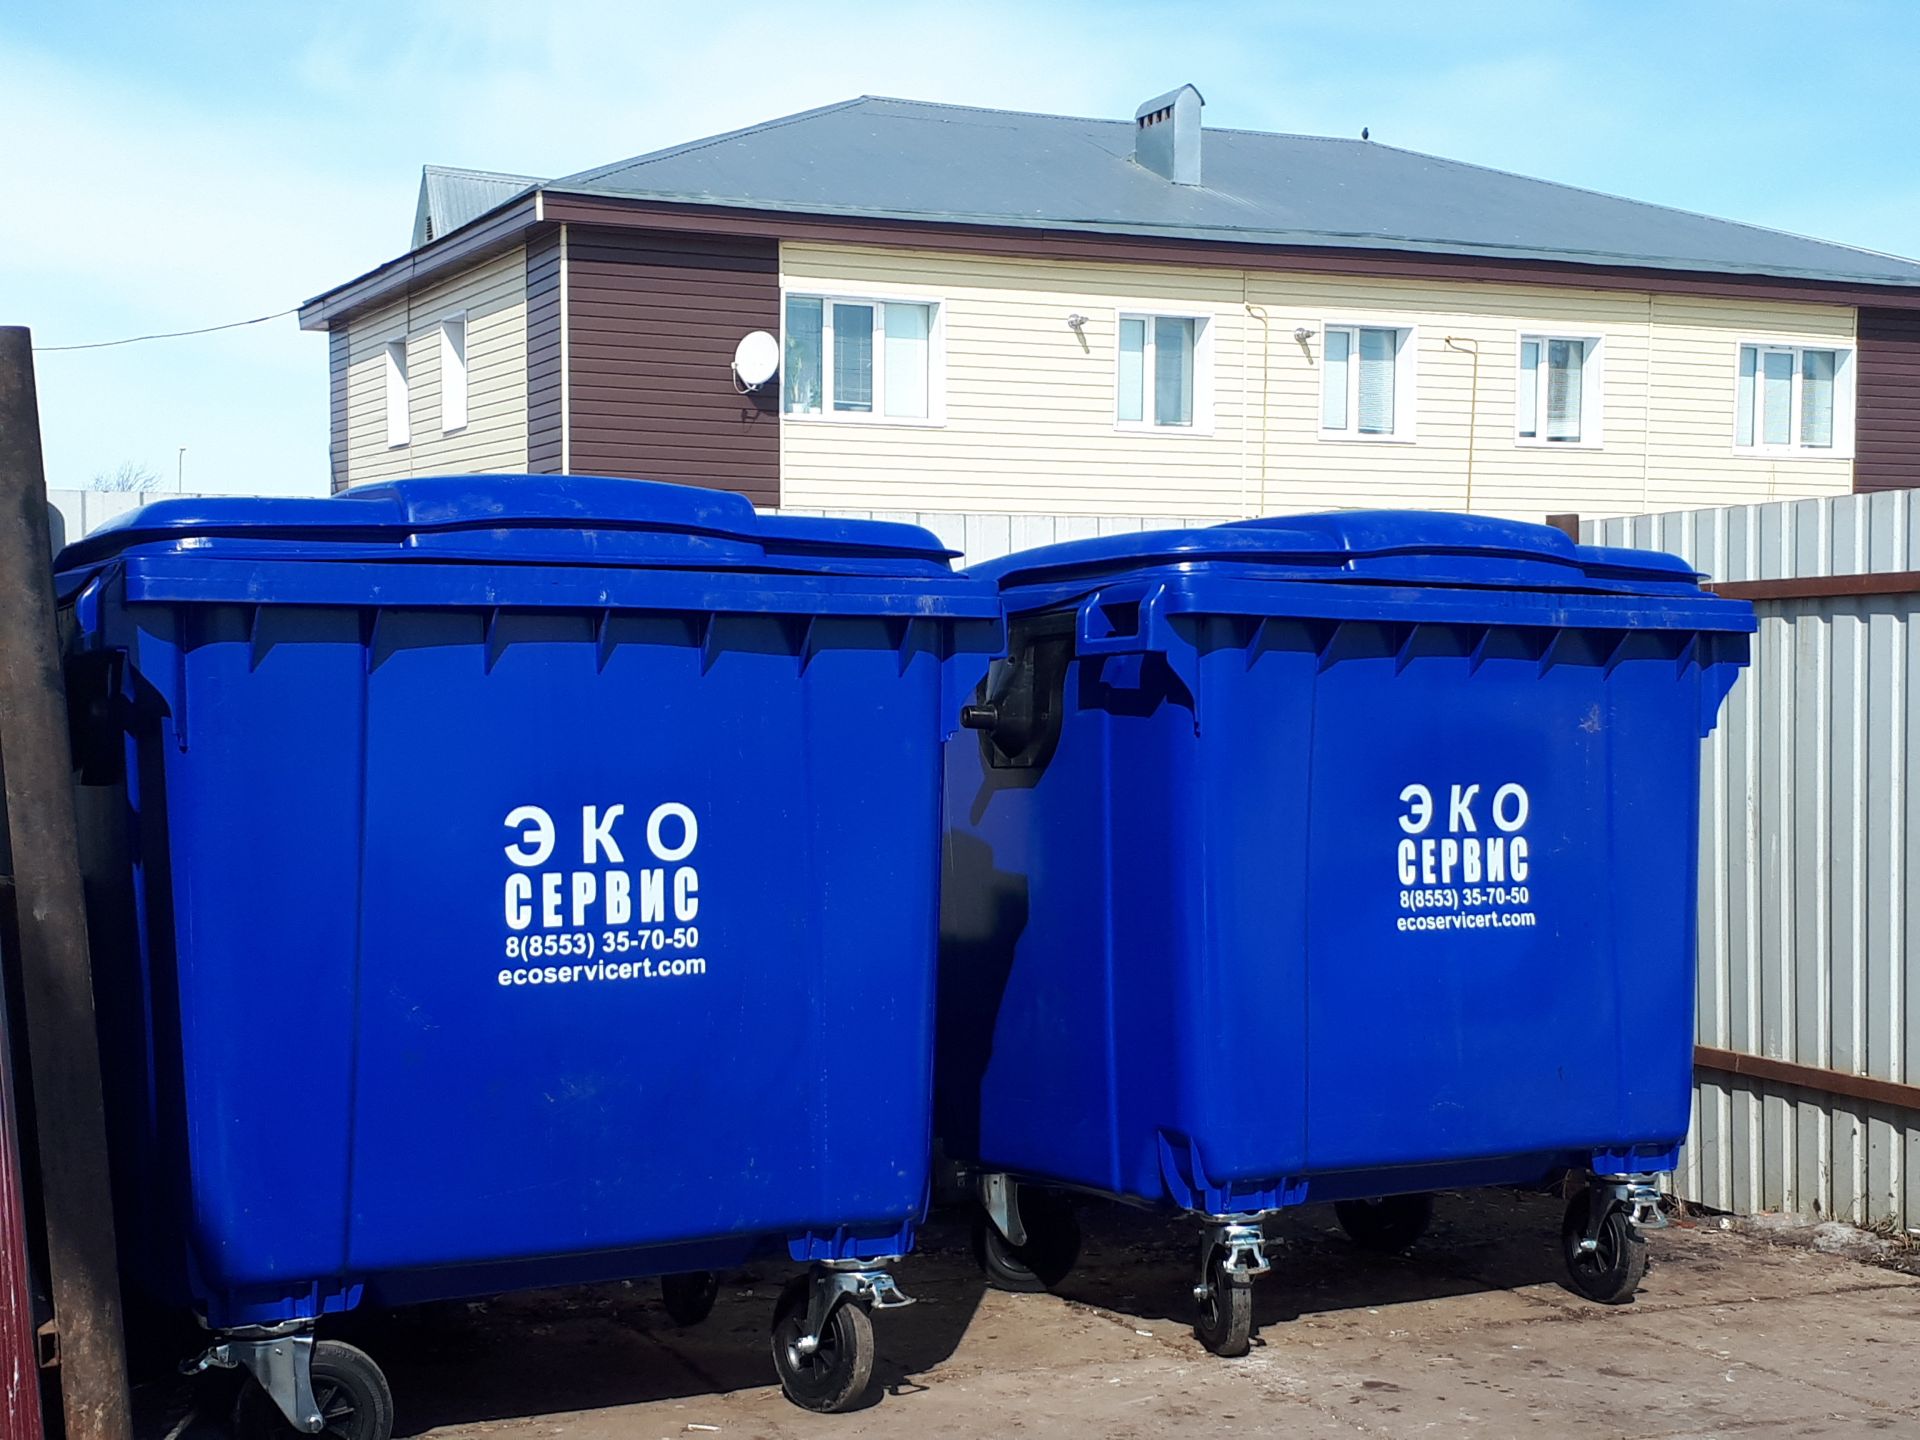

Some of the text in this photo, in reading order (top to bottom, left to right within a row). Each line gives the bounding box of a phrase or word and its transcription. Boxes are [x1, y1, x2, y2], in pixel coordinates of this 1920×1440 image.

[1397, 836, 1529, 886] СЕРВИС
[504, 866, 700, 930] СЕРВИС
[1399, 886, 1529, 912] 8(8553) 35-70-50
[1396, 911, 1537, 931] ecoservicert.com
[505, 926, 699, 962] 8(8553) 35-70-50
[497, 957, 706, 986] ecoservicert.com
